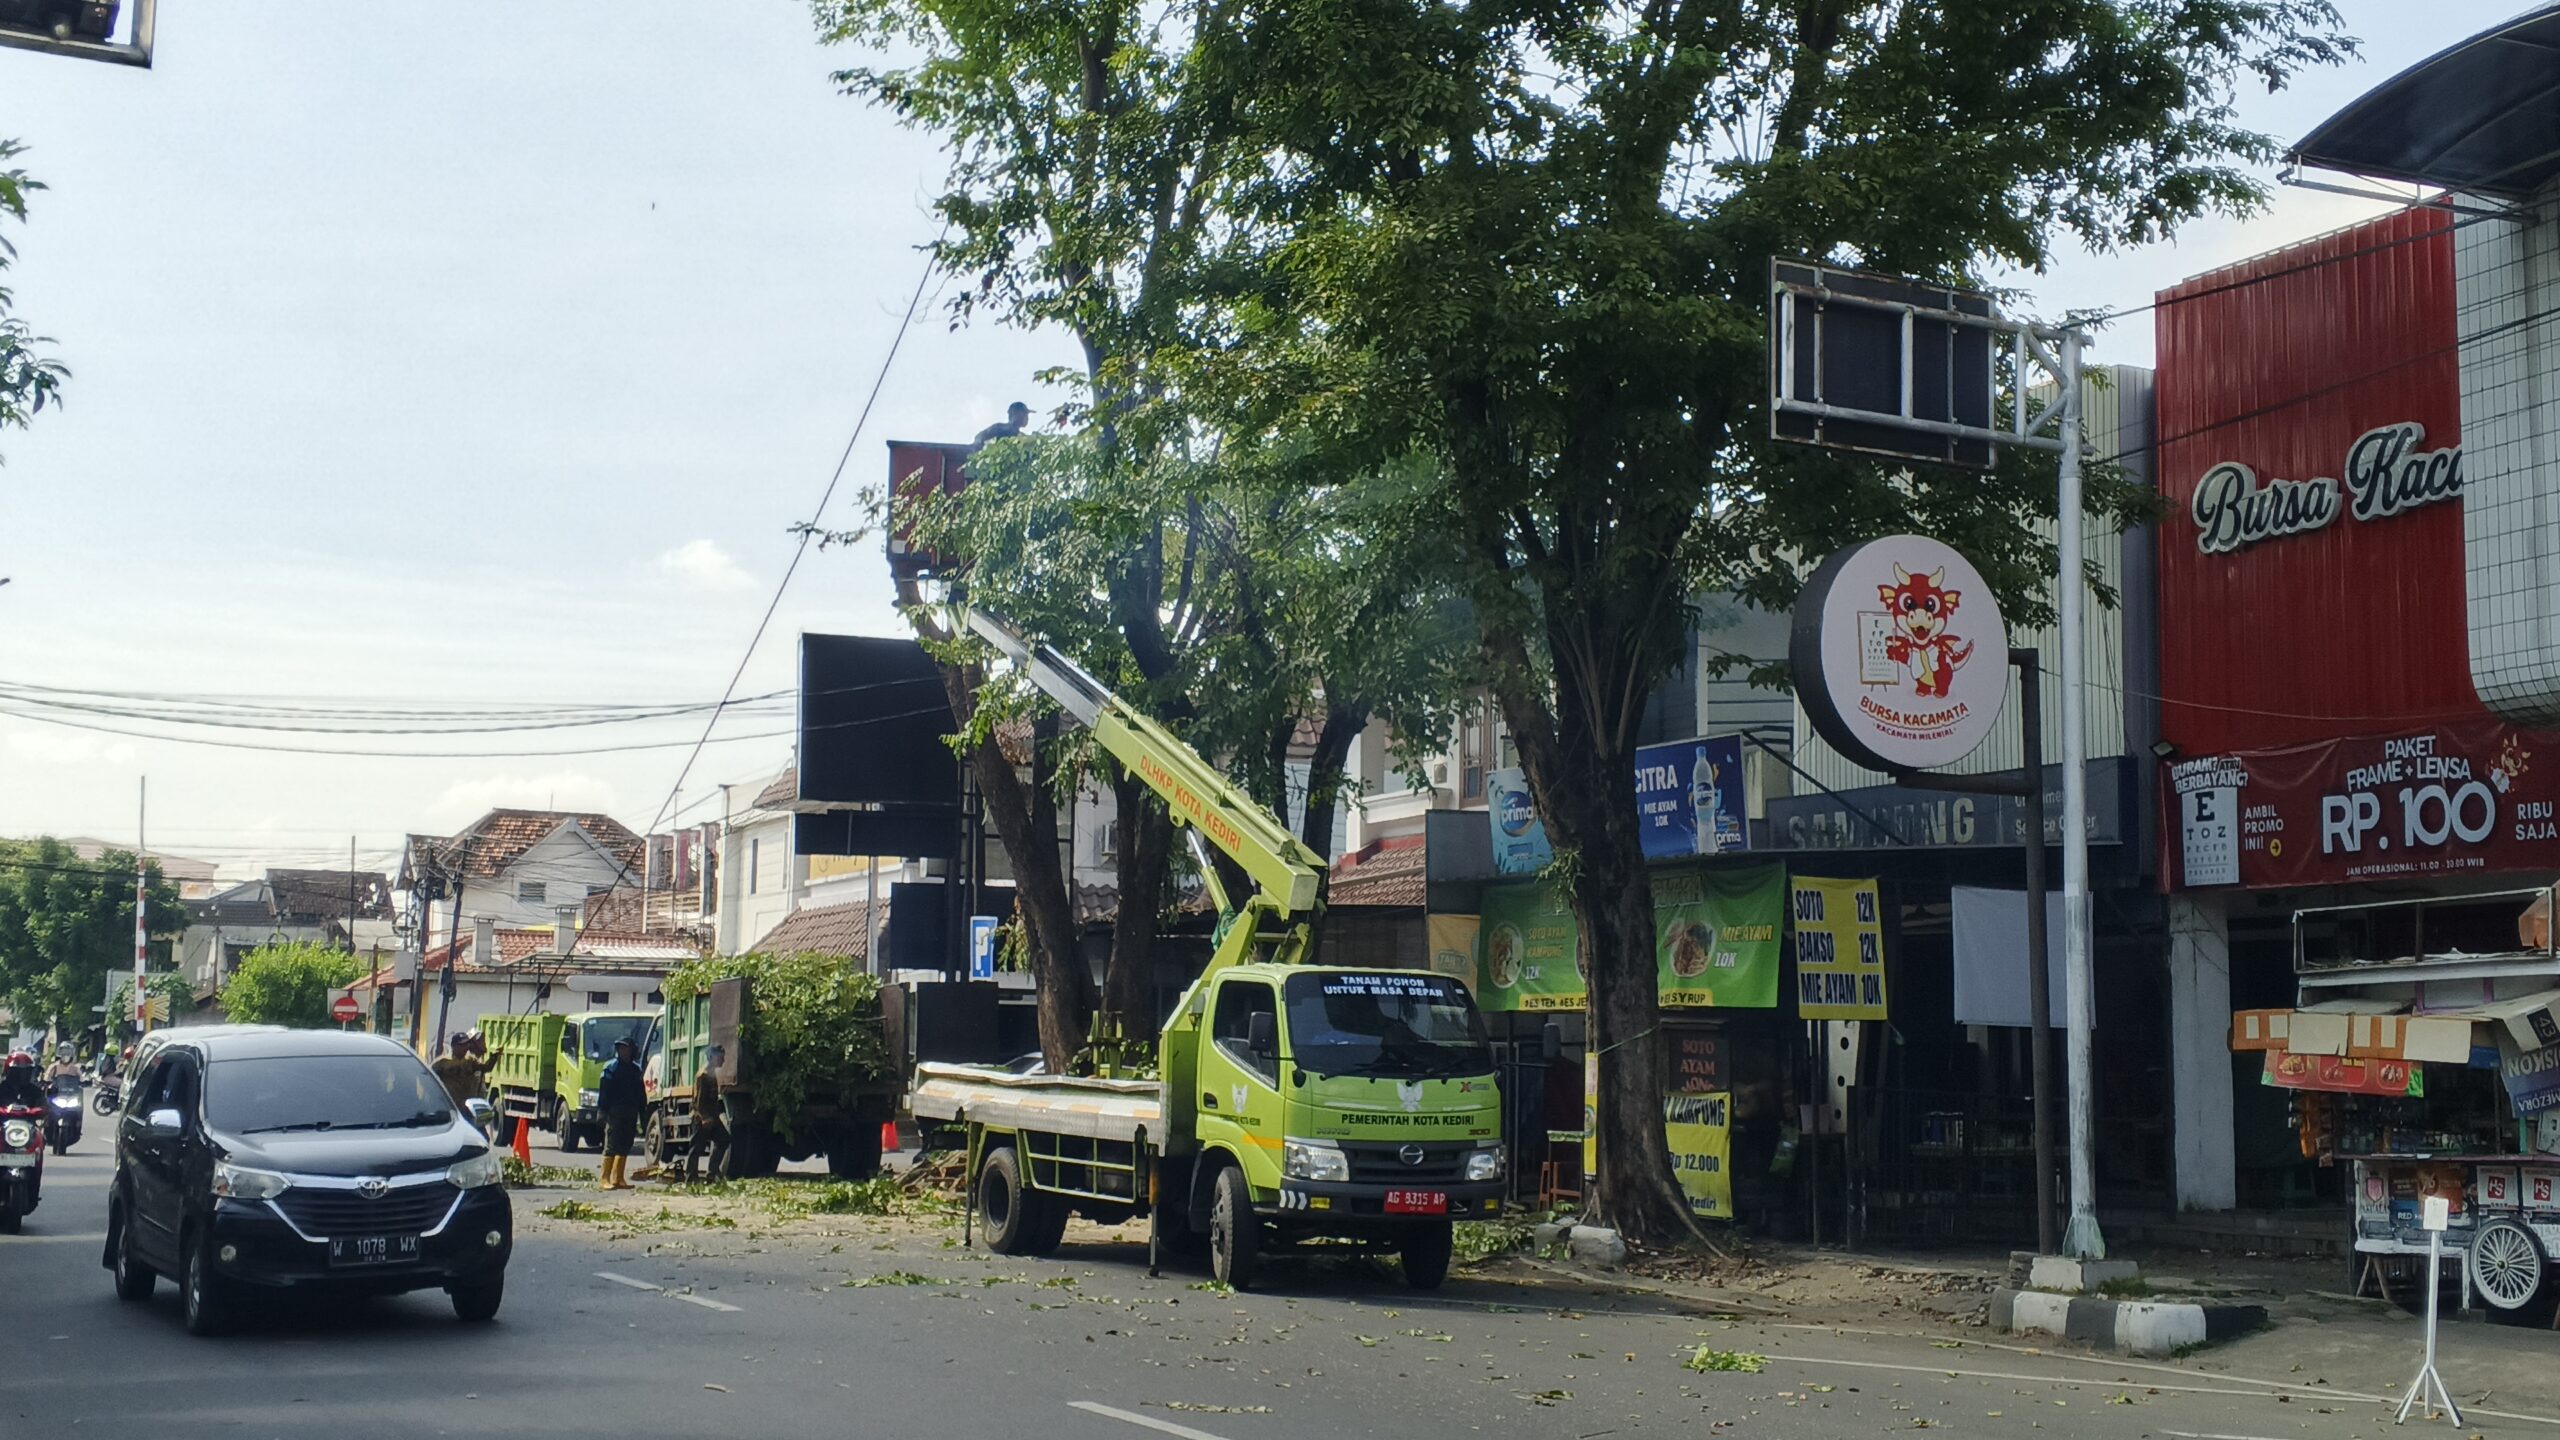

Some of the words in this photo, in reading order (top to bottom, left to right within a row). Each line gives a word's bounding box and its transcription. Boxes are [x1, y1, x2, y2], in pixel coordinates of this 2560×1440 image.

[2195, 464, 2337, 551] Bursa
[1860, 695, 1901, 723] BURSA
[1903, 702, 1969, 726] KACAMATA
[1876, 724, 1917, 740] KACAMATA
[1919, 728, 1954, 741] MILENIAL
[2385, 735, 2436, 759] PAKET
[2346, 759, 2402, 792] FRAME
[2416, 757, 2472, 780] LENSA
[1140, 754, 1173, 790] DLHKP
[1175, 784, 1201, 819] KOTA
[1204, 810, 1241, 852] KEDIRI
[1658, 800, 1678, 813] AYAM
[2195, 791, 2215, 822] E
[2245, 804, 2277, 819] AMBIL
[2517, 801, 2553, 820] RIBU
[1655, 815, 1669, 828] 10K
[2245, 818, 2284, 834] PROMO
[2322, 792, 2389, 854] RP.
[2399, 781, 2496, 847] 100
[2515, 822, 2557, 841] SAJA
[2346, 867, 2361, 876] JAM
[2362, 863, 2418, 875] OPERASIONAL:
[2467, 858, 2485, 867] WIB
[1796, 890, 1824, 921] SOTO
[1856, 892, 1876, 922] 12K
[1720, 926, 1742, 942] MIE
[1743, 925, 1773, 941] AYAM
[1798, 932, 1834, 963] BAKSO
[1859, 933, 1878, 963] 12K
[1714, 952, 1737, 967] 10K
[1324, 985, 1366, 995] UNTUK
[1370, 986, 1404, 995] MASA
[1409, 987, 1444, 997] DEPAN
[1340, 976, 1381, 985] TANAM
[1386, 977, 1425, 987] POHON
[1801, 973, 1822, 1004] MIE
[1825, 973, 1857, 1004] AYAM
[1861, 974, 1882, 1005] 10K
[1682, 1040, 1715, 1054] SOTO
[1680, 1059, 1716, 1075] AYAM
[2507, 1047, 2560, 1078] ISKON
[1341, 1114, 1409, 1126] PEMERINTAH
[1413, 1115, 1440, 1126] KOTA
[1443, 1115, 1474, 1126] KEDIRI
[1685, 1153, 1720, 1172] 12.000
[1387, 1192, 1400, 1203] AG
[1433, 1193, 1446, 1205] AP
[333, 1241, 343, 1256] W
[357, 1238, 386, 1255] 1078
[400, 1236, 417, 1252] WX
